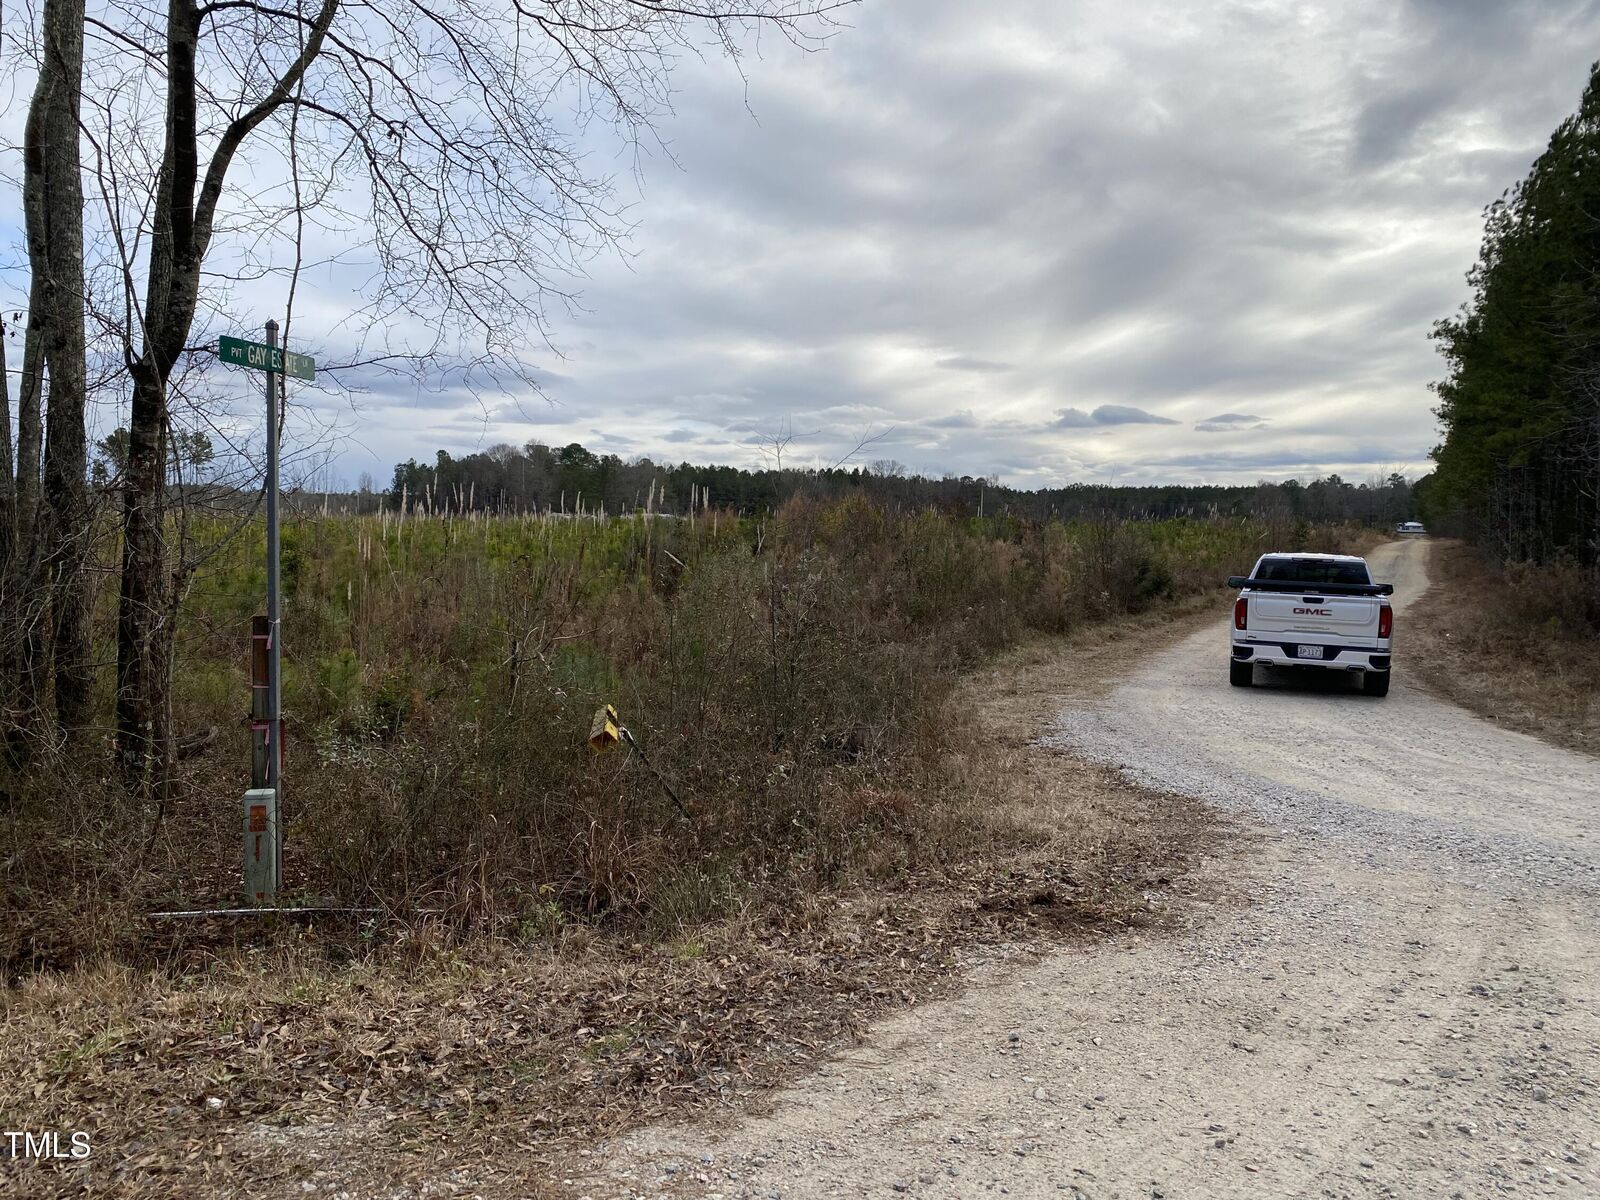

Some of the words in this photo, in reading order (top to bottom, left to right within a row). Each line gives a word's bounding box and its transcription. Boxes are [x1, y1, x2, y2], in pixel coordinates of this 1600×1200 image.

[231, 347, 242, 358] PVT
[247, 345, 267, 366] GAY
[271, 350, 298, 373] ESATE
[1293, 607, 1333, 616] GMC
